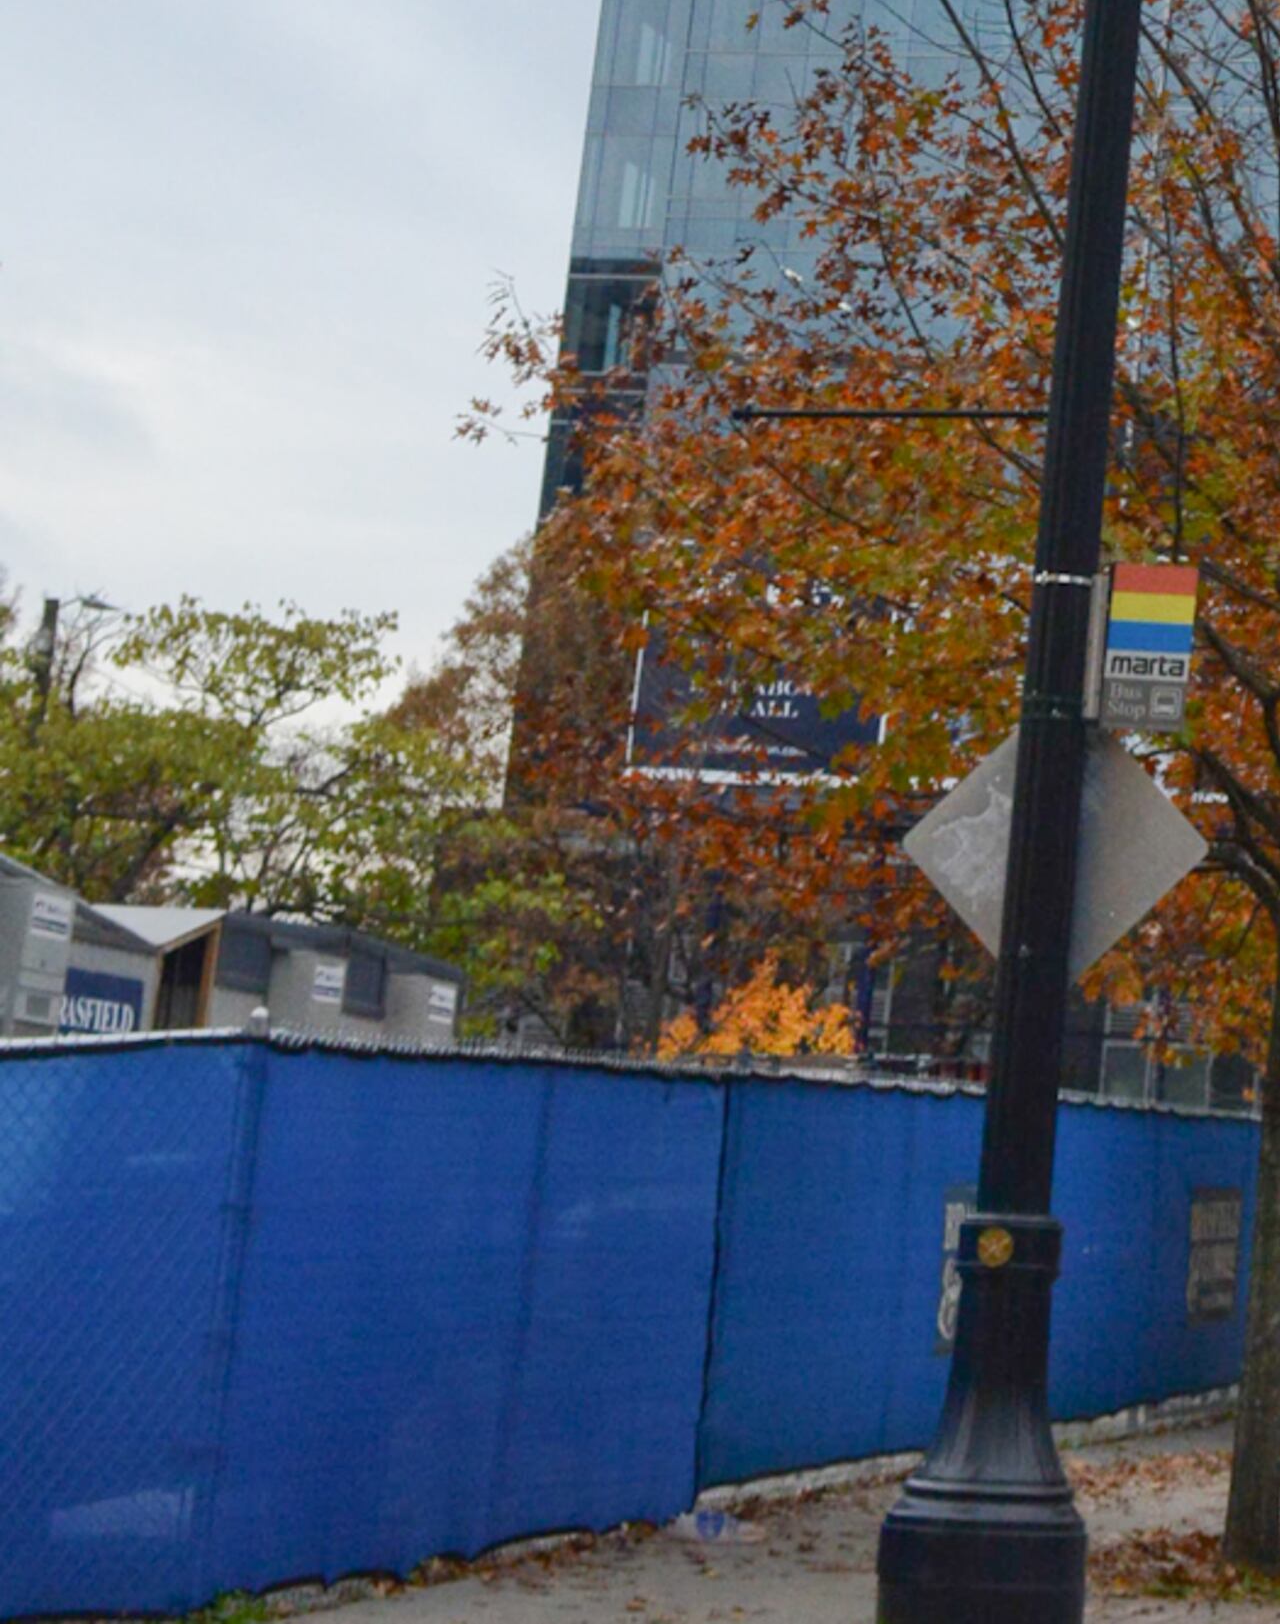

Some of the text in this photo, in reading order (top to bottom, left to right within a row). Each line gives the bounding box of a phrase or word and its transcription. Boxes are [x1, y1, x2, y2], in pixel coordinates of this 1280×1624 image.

[1110, 655, 1186, 678] marta
[1110, 681, 1143, 700] Bus
[1107, 699, 1147, 722] Stop
[60, 994, 136, 1032] RASFIELD
